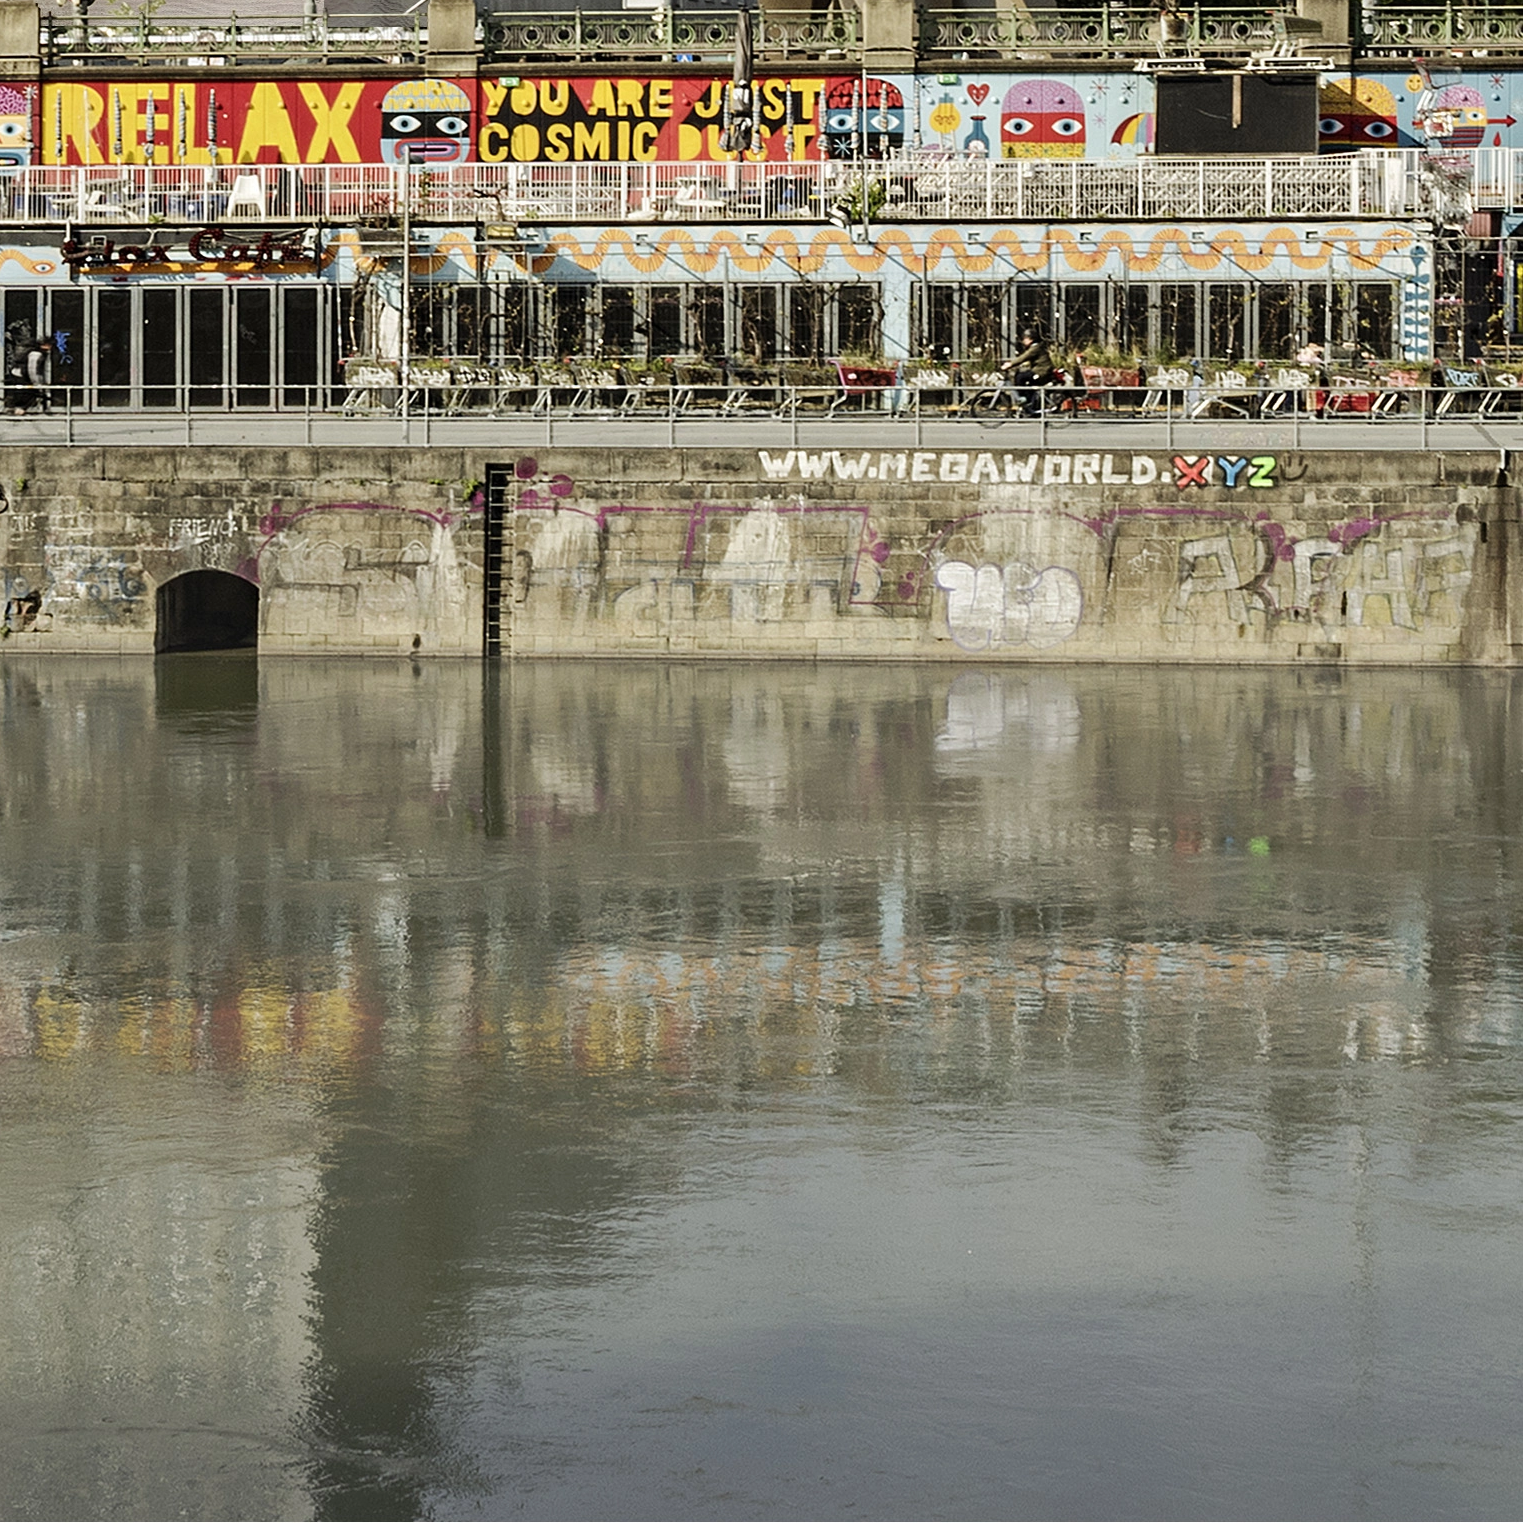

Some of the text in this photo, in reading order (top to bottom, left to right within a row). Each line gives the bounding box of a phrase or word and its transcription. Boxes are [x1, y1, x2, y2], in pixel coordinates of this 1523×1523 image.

[481, 79, 569, 116] YOU
[588, 79, 673, 117] ARE
[43, 82, 365, 165] RELAX
[479, 122, 658, 161] COSMIC
